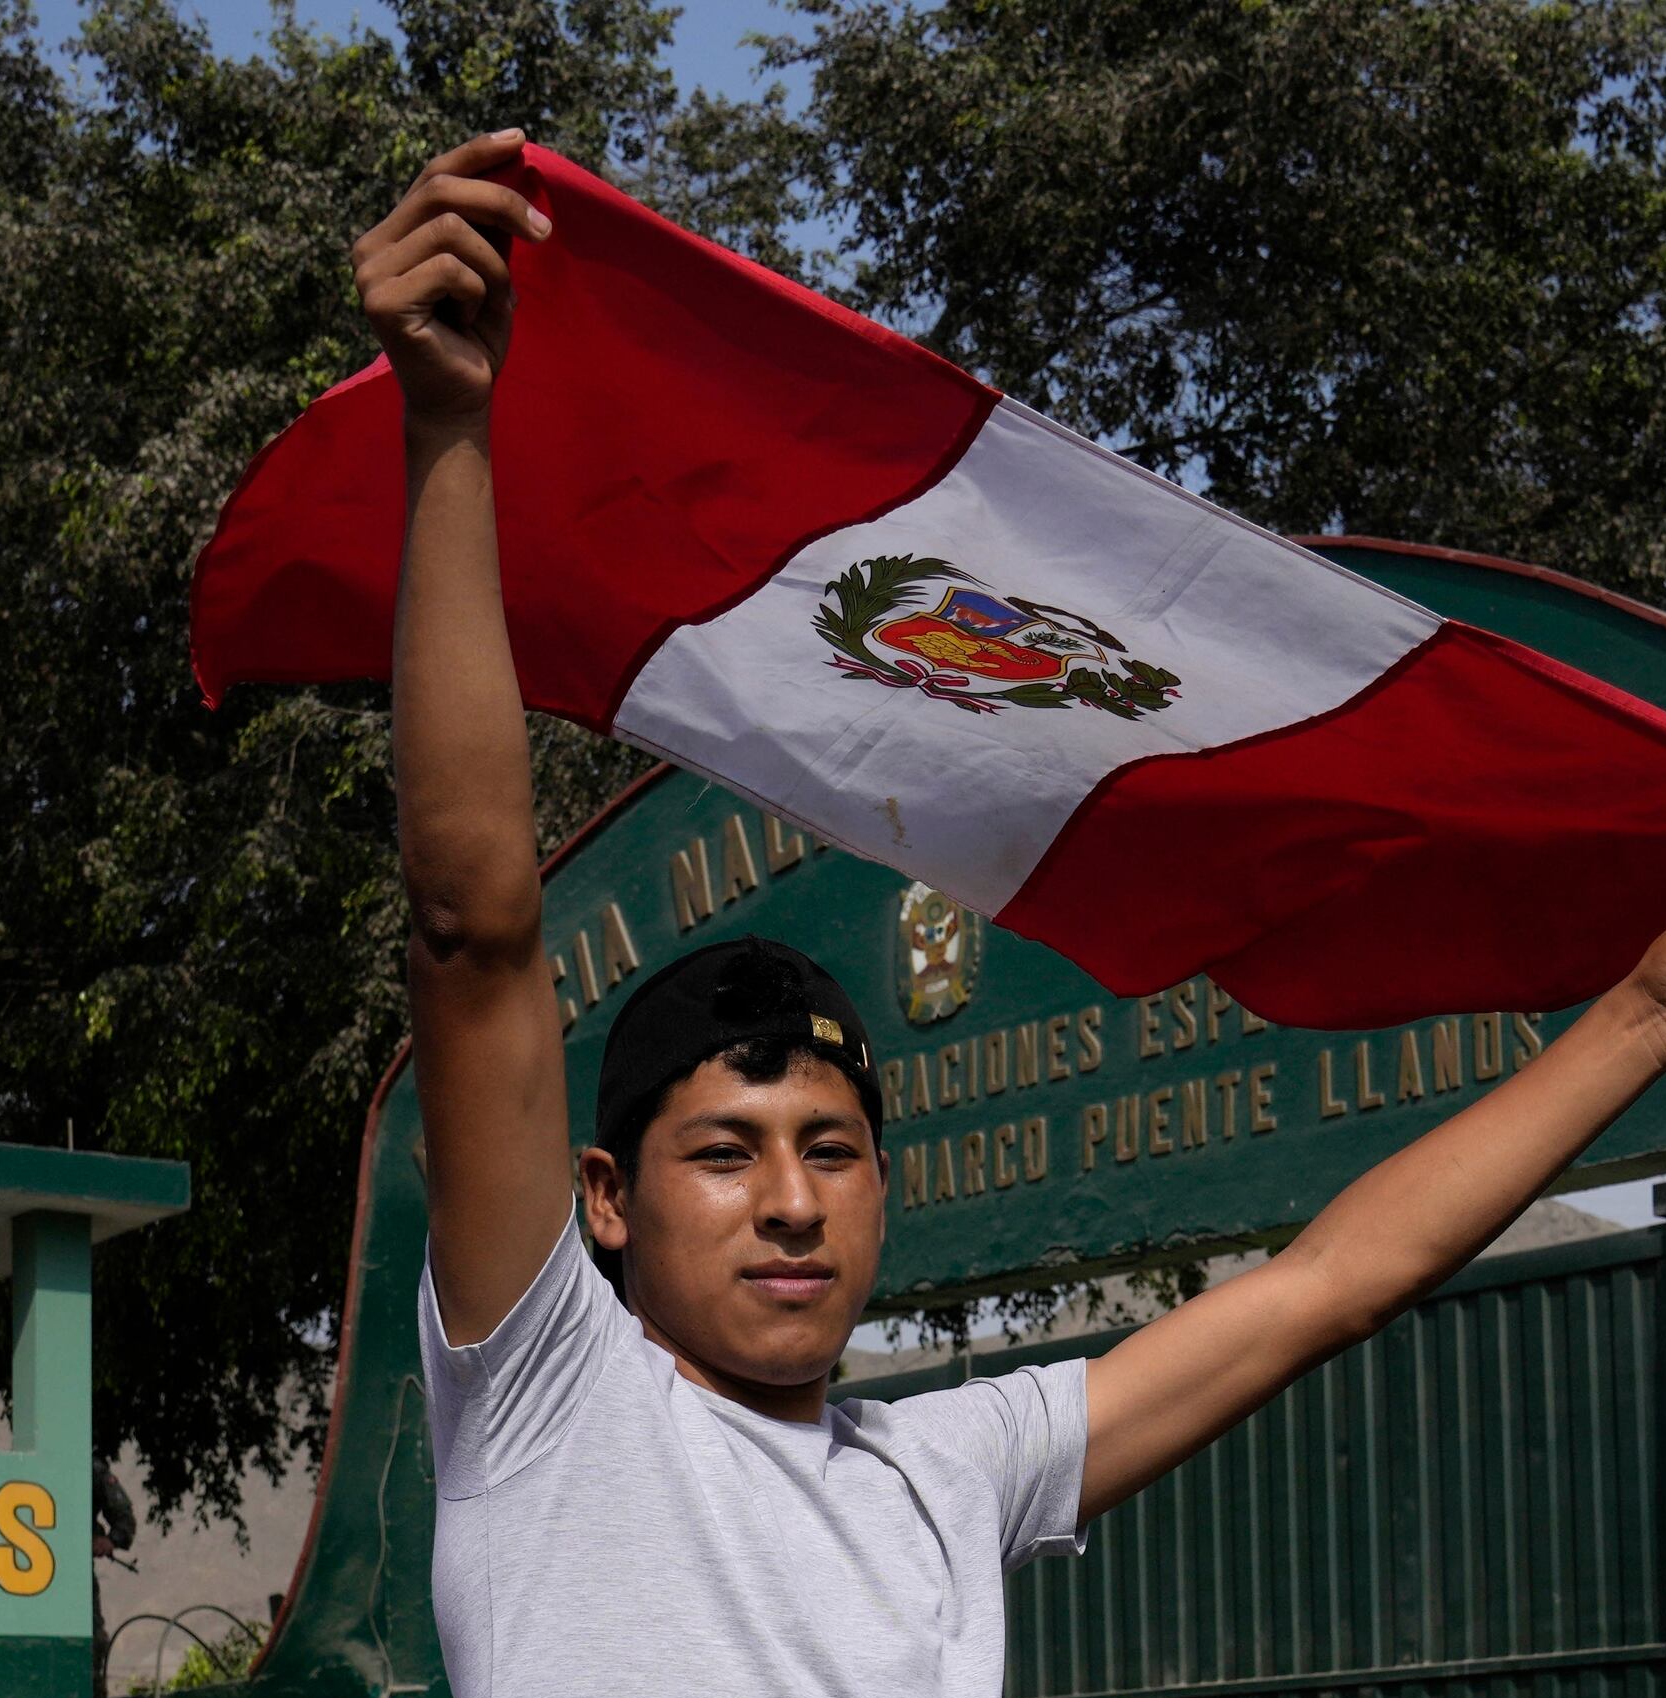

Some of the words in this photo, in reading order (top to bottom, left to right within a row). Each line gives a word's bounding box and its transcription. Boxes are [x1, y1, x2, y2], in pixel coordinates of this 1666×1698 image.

[883, 1005, 1103, 1123] RACIONES
[902, 1114, 1048, 1210] MARCO
[1082, 1062, 1278, 1173] PUENTE
[1319, 1010, 1544, 1120] LLANOS
